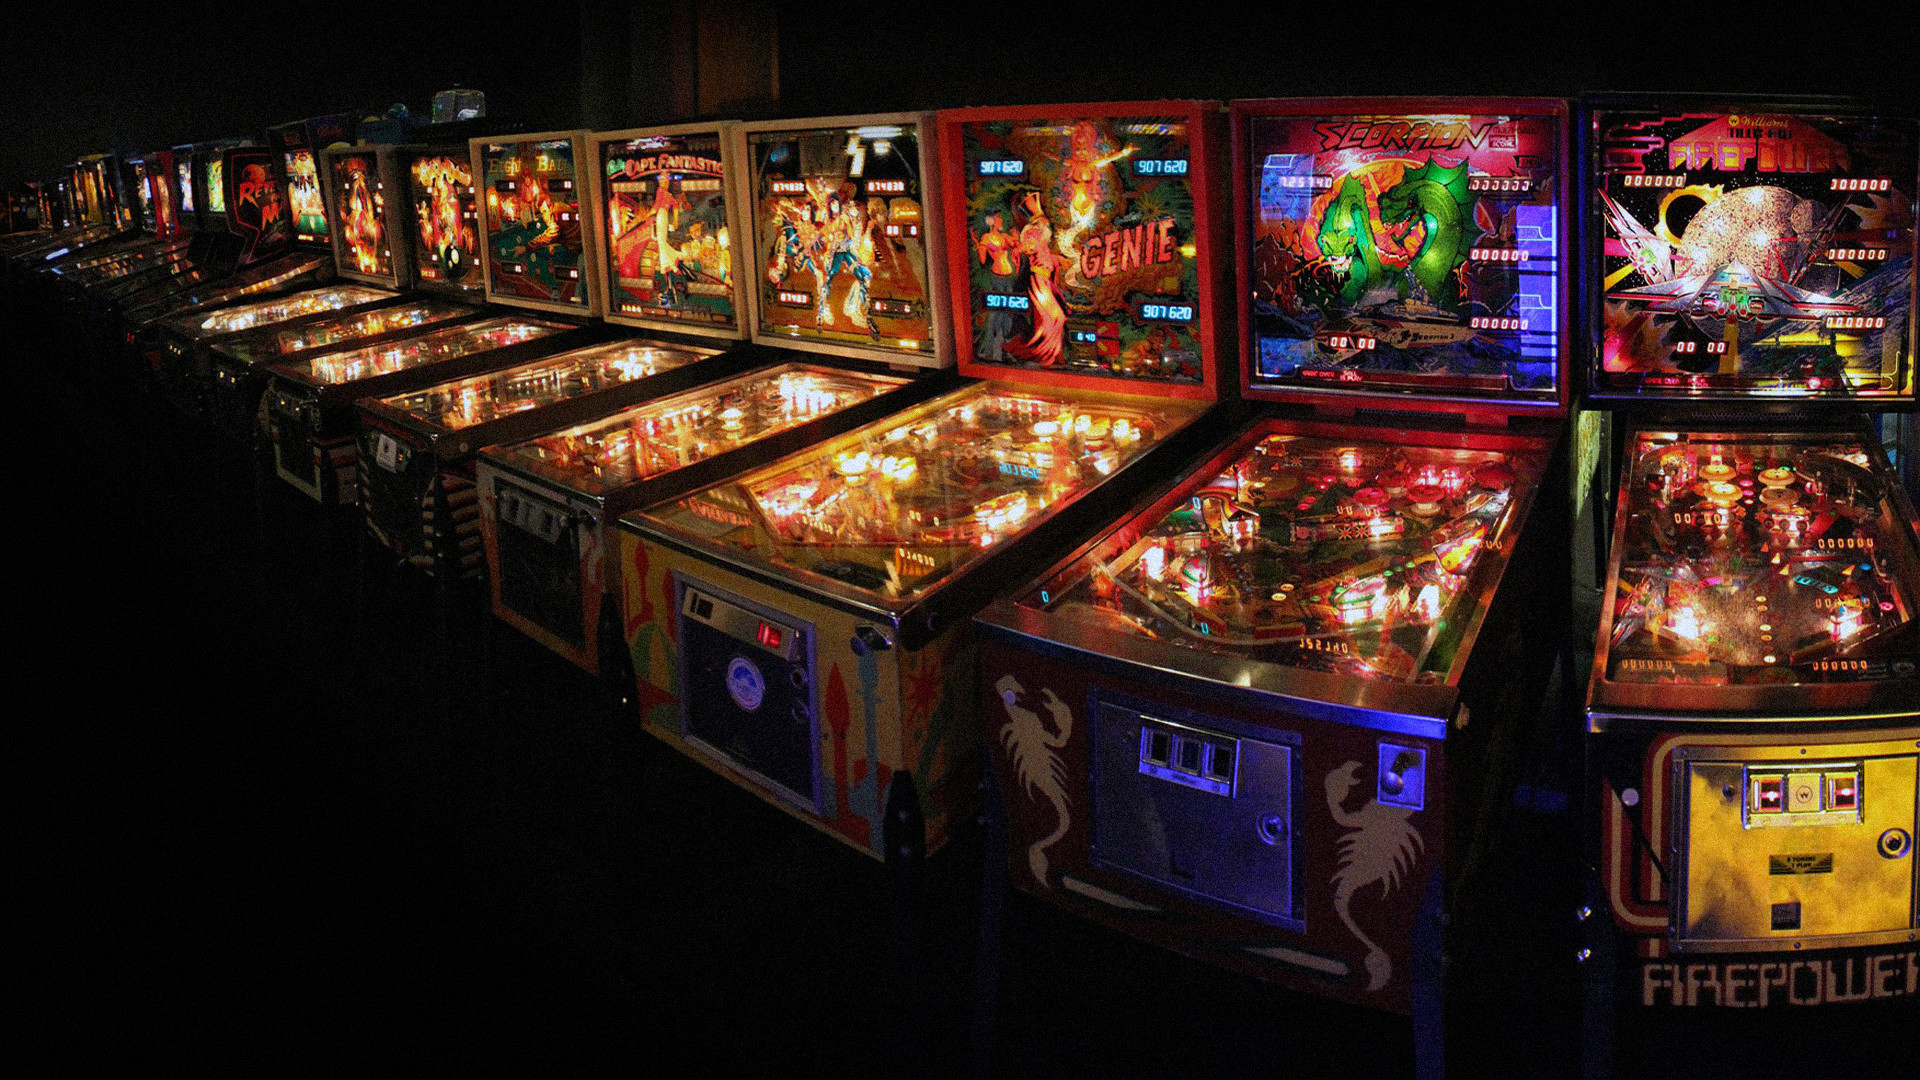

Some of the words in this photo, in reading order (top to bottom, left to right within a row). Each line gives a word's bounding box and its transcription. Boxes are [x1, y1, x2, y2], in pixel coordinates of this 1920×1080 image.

[1741, 115, 1789, 128] Williams
[1313, 119, 1500, 151] SCORPION
[1625, 175, 1683, 187] 000000
[1081, 217, 1175, 279] GENIE
[1471, 250, 1529, 261] 000000
[1829, 249, 1885, 260] 000000
[1471, 318, 1528, 330] 000000
[1827, 317, 1884, 328] 000000
[1677, 342, 1694, 352] 00
[1707, 343, 1725, 352] 00
